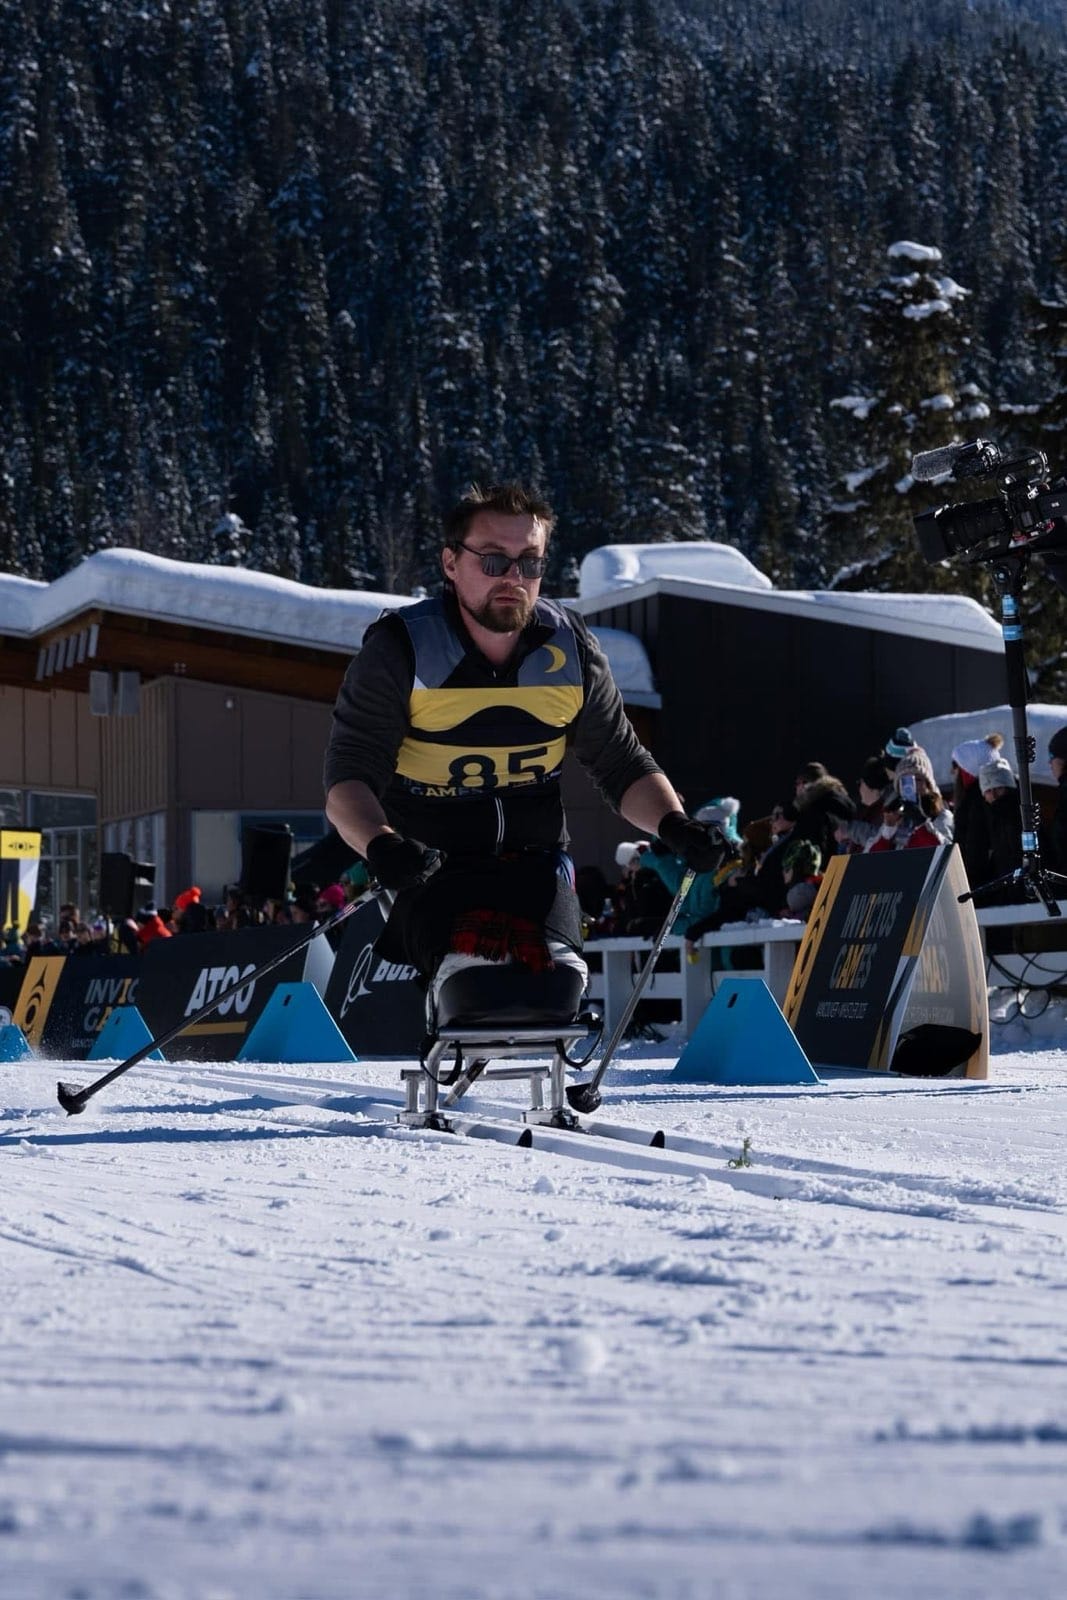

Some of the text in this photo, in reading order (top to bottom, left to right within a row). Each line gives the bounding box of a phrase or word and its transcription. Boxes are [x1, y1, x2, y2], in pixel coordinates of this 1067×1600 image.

[448, 747, 548, 788] 85
[841, 892, 903, 938] INVICTUS
[830, 944, 878, 989] GAMES
[184, 963, 257, 1017] ATCO
